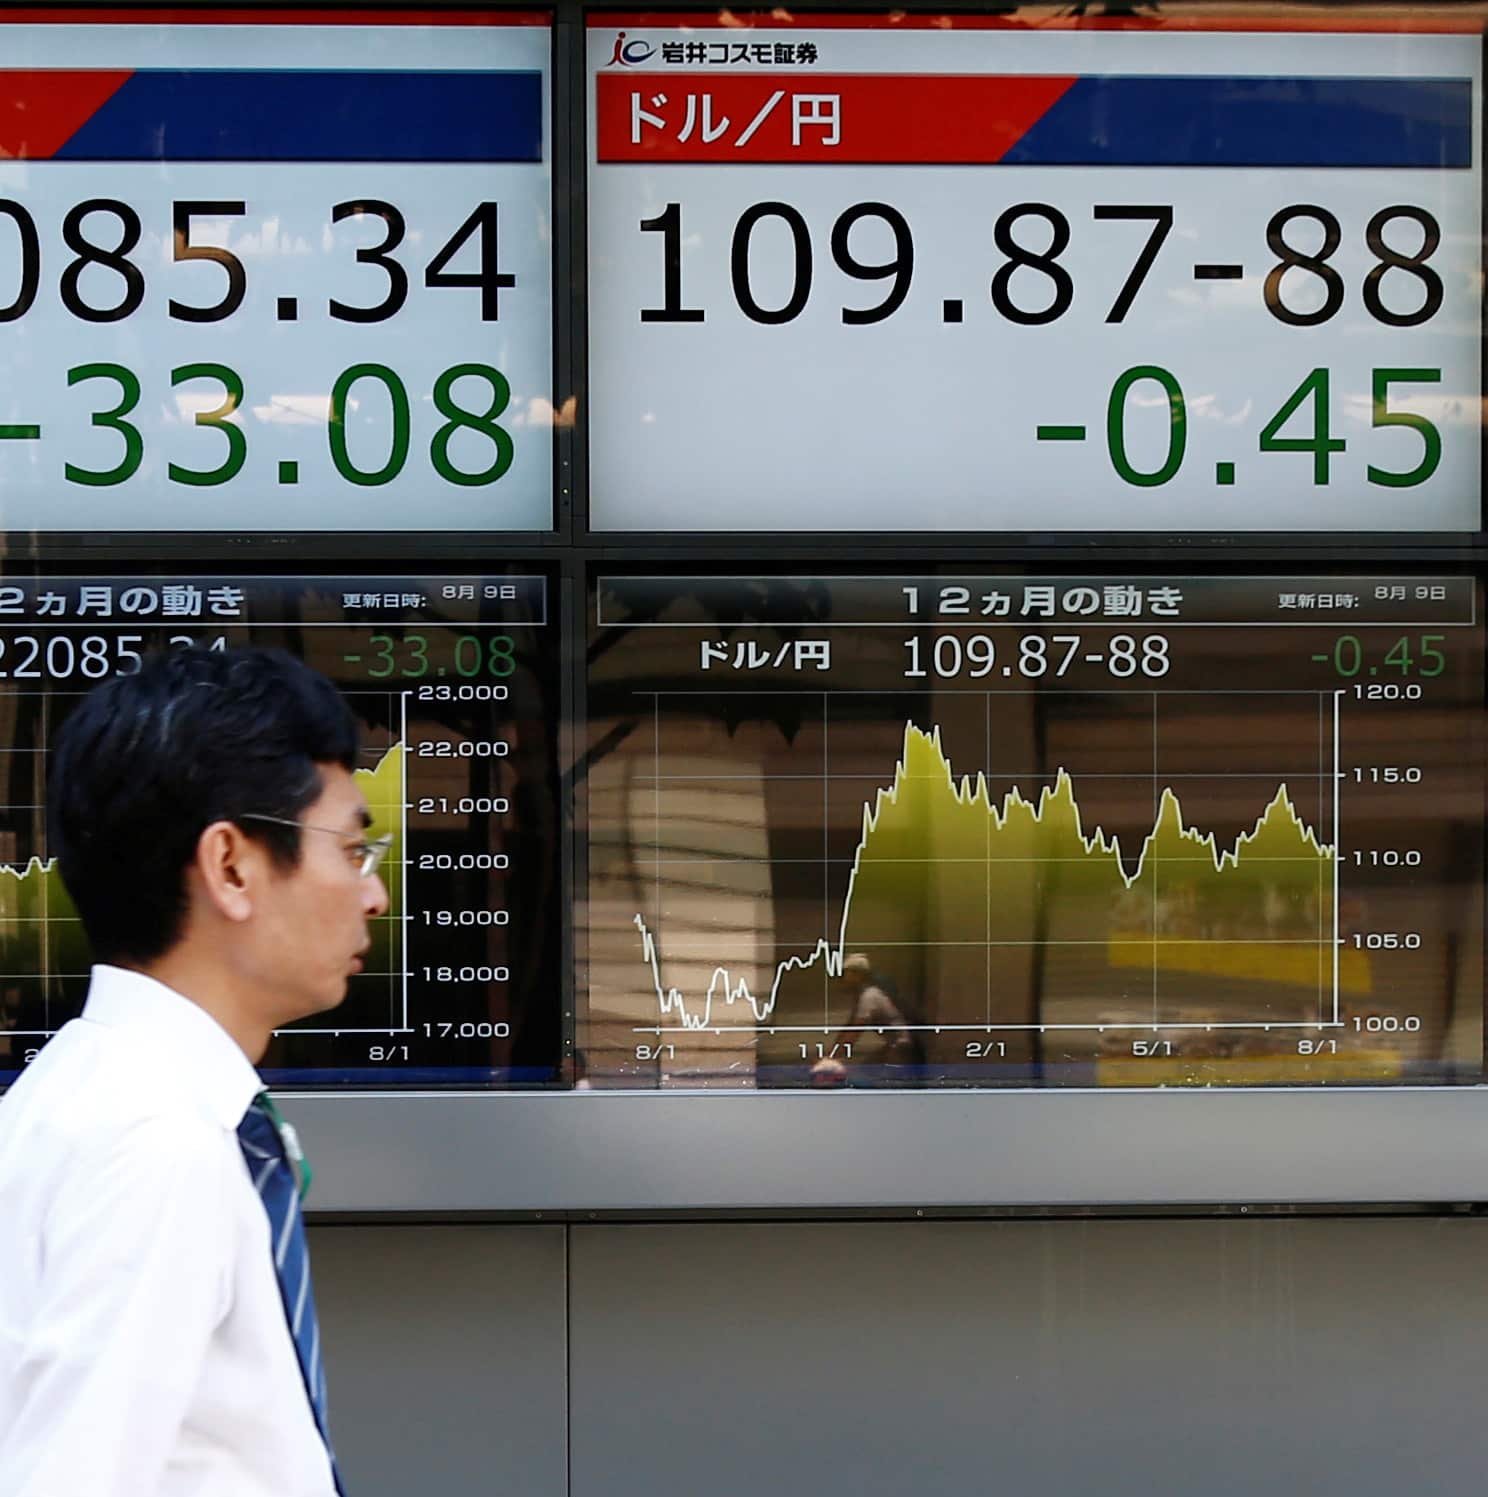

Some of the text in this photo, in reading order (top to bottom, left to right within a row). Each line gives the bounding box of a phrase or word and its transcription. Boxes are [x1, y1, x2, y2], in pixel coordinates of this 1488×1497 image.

[661, 41, 818, 65] 岩井コスモ証券
[627, 90, 842, 147] ドル/円
[638, 201, 1444, 326] 109.87-88
[1036, 365, 1443, 488] -0.45
[344, 635, 516, 678] -33.08
[700, 635, 1445, 678] ドル/円 109.87-88 -0.45
[418, 685, 508, 702] 23,000
[1353, 684, 1422, 700] 120.0
[418, 741, 509, 758] 22,000
[1352, 768, 1422, 784] 115.0
[418, 798, 509, 815] 21,000
[419, 854, 509, 870] 20,000
[1352, 851, 1421, 866] 110.0
[422, 910, 509, 927] 19,000
[1352, 934, 1421, 949] 105.0
[423, 966, 509, 983] 18,000
[423, 1022, 510, 1039] 17,000
[1352, 1017, 1421, 1032] 100.0
[369, 1046, 408, 1062] 8/1
[635, 1045, 675, 1060] 8/1
[799, 1043, 853, 1059] 11/1
[966, 1042, 1006, 1058] 2/1
[1132, 1041, 1172, 1056] 5/1
[1297, 1040, 1338, 1055] 8/1
